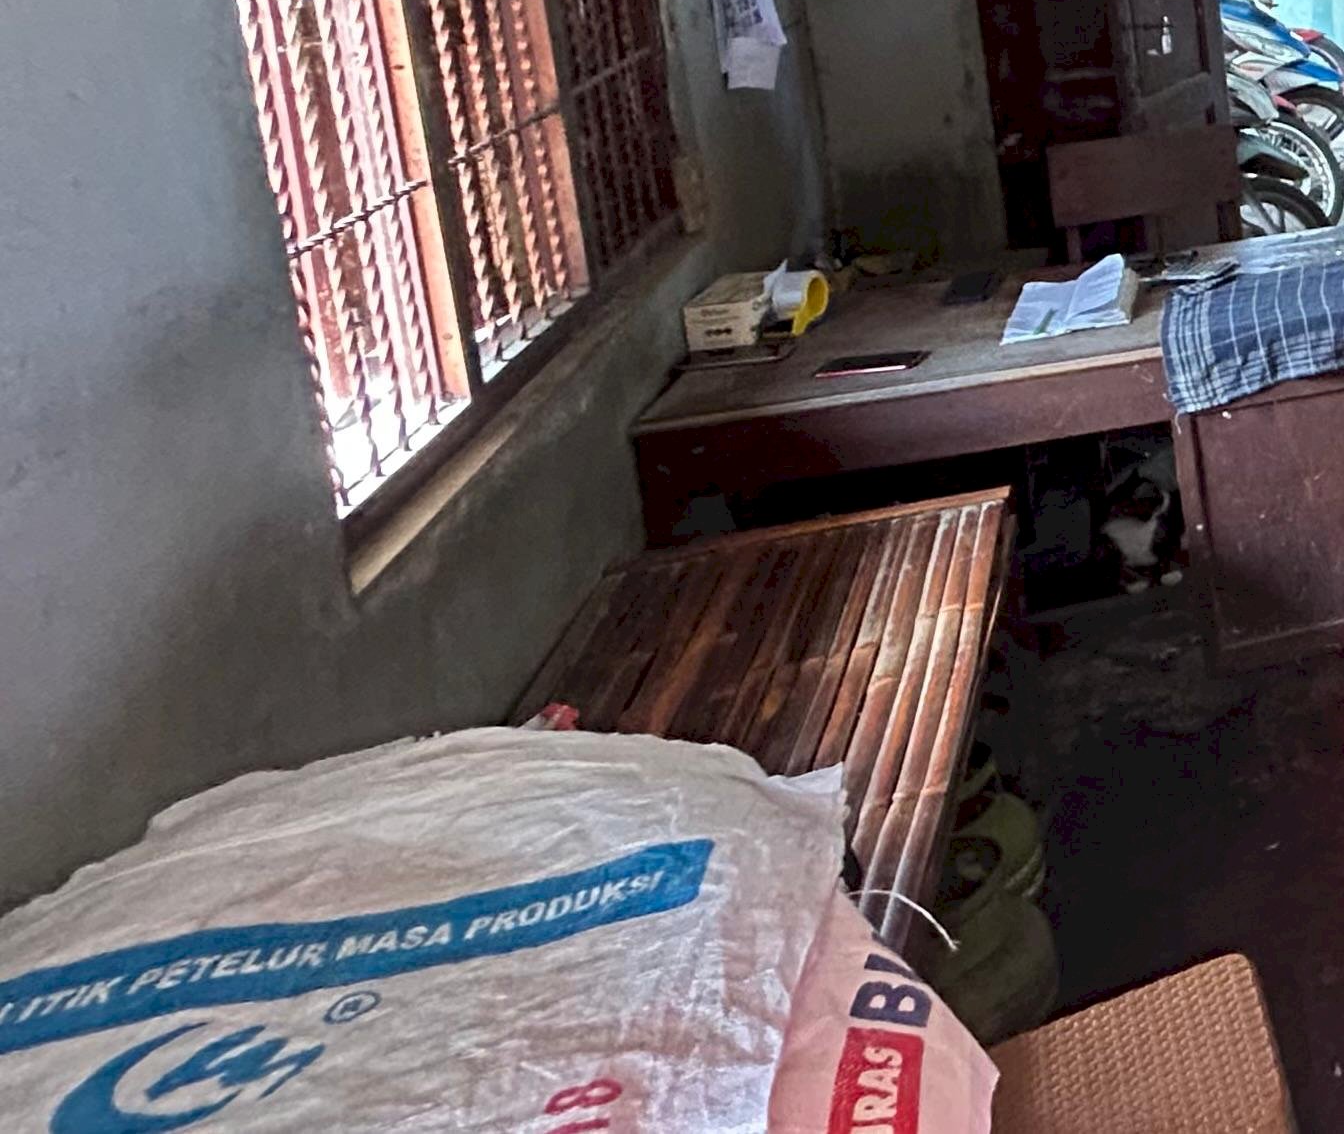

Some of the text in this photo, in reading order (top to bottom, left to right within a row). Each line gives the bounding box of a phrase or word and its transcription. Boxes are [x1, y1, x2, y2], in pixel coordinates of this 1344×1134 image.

[14, 974, 127, 1024] ITIK
[128, 941, 330, 995] PETELUR
[335, 921, 452, 961] MASA
[463, 870, 666, 941] PRODUKSI
